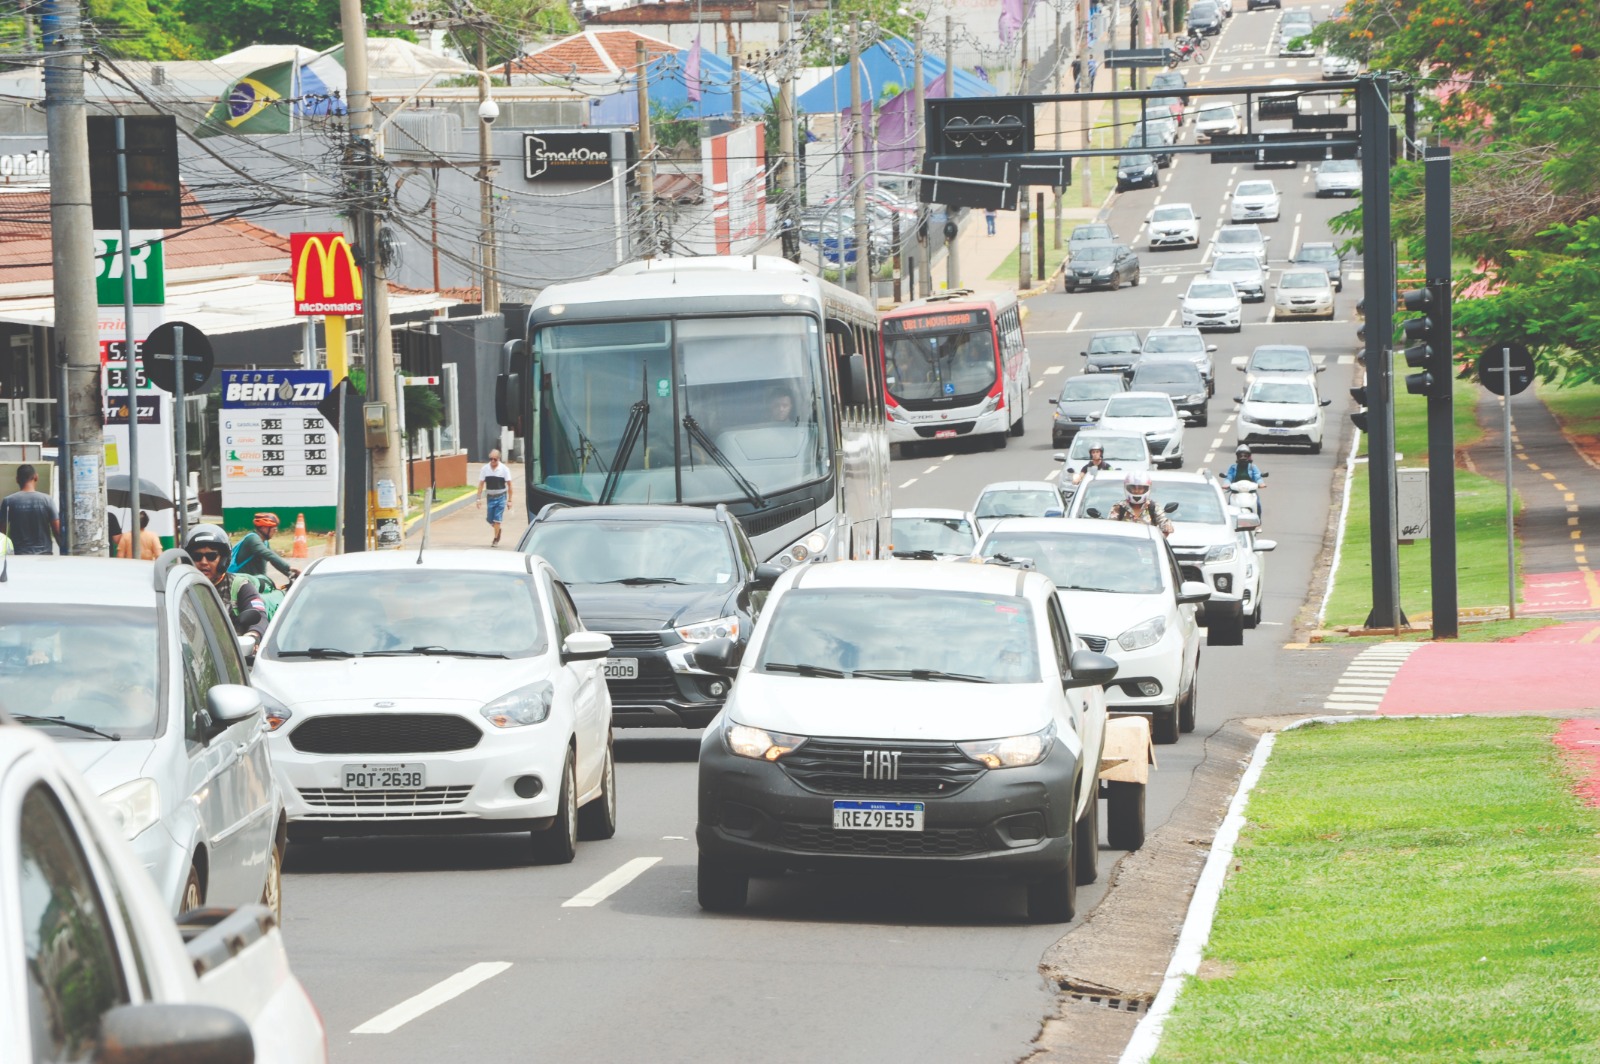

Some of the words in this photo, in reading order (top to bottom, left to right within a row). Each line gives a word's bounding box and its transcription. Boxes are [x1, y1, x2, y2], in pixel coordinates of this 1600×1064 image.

[535, 148, 607, 161] SmartOne
[299, 303, 361, 312] McDonald's
[111, 369, 147, 388] 3,5
[229, 374, 274, 383] REDE
[225, 421, 232, 429] G
[262, 420, 281, 429] 5,35
[304, 418, 324, 428] 5,50
[226, 436, 232, 444] G
[263, 434, 283, 444] 5,45
[305, 433, 326, 443] 5,60
[263, 451, 284, 460] 3,35
[264, 466, 284, 475] 5,99
[307, 466, 327, 475] 5,99
[604, 666, 634, 676] 2009
[863, 750, 902, 780] FIAT
[842, 811, 915, 828] REZ9E55
